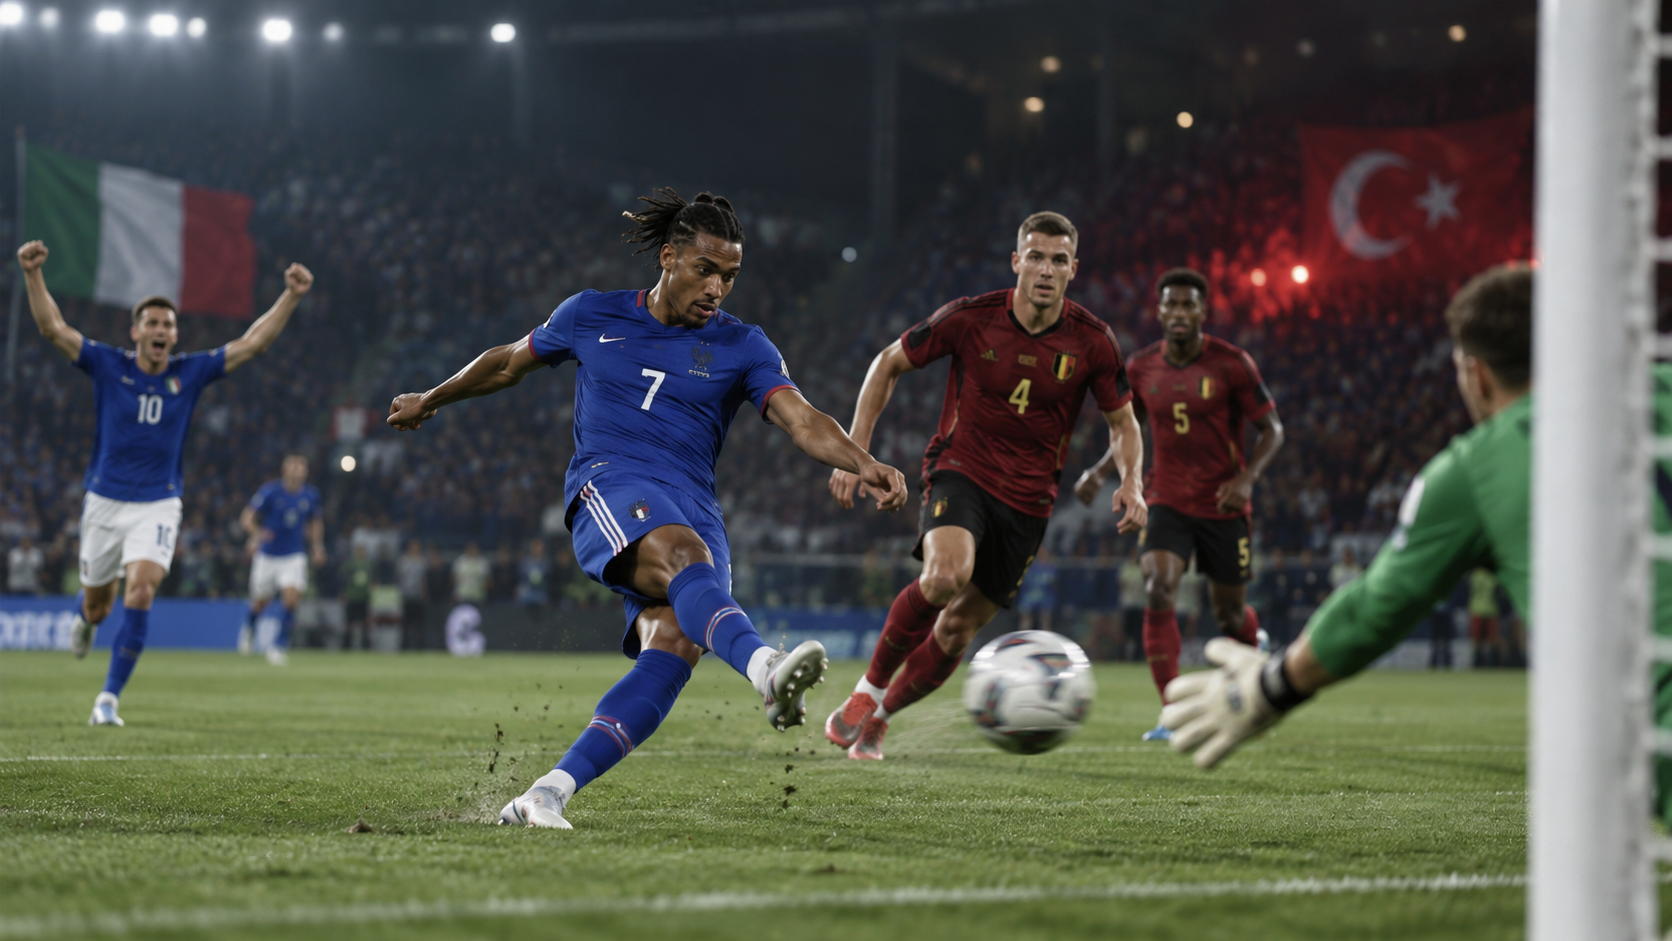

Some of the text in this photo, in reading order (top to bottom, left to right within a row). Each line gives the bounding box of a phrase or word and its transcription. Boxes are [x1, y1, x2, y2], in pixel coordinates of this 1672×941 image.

[641, 368, 666, 411] 7
[1008, 378, 1032, 415] 4
[137, 393, 164, 425] 10
[1173, 402, 1190, 435] 5
[1237, 537, 1250, 567] 5
